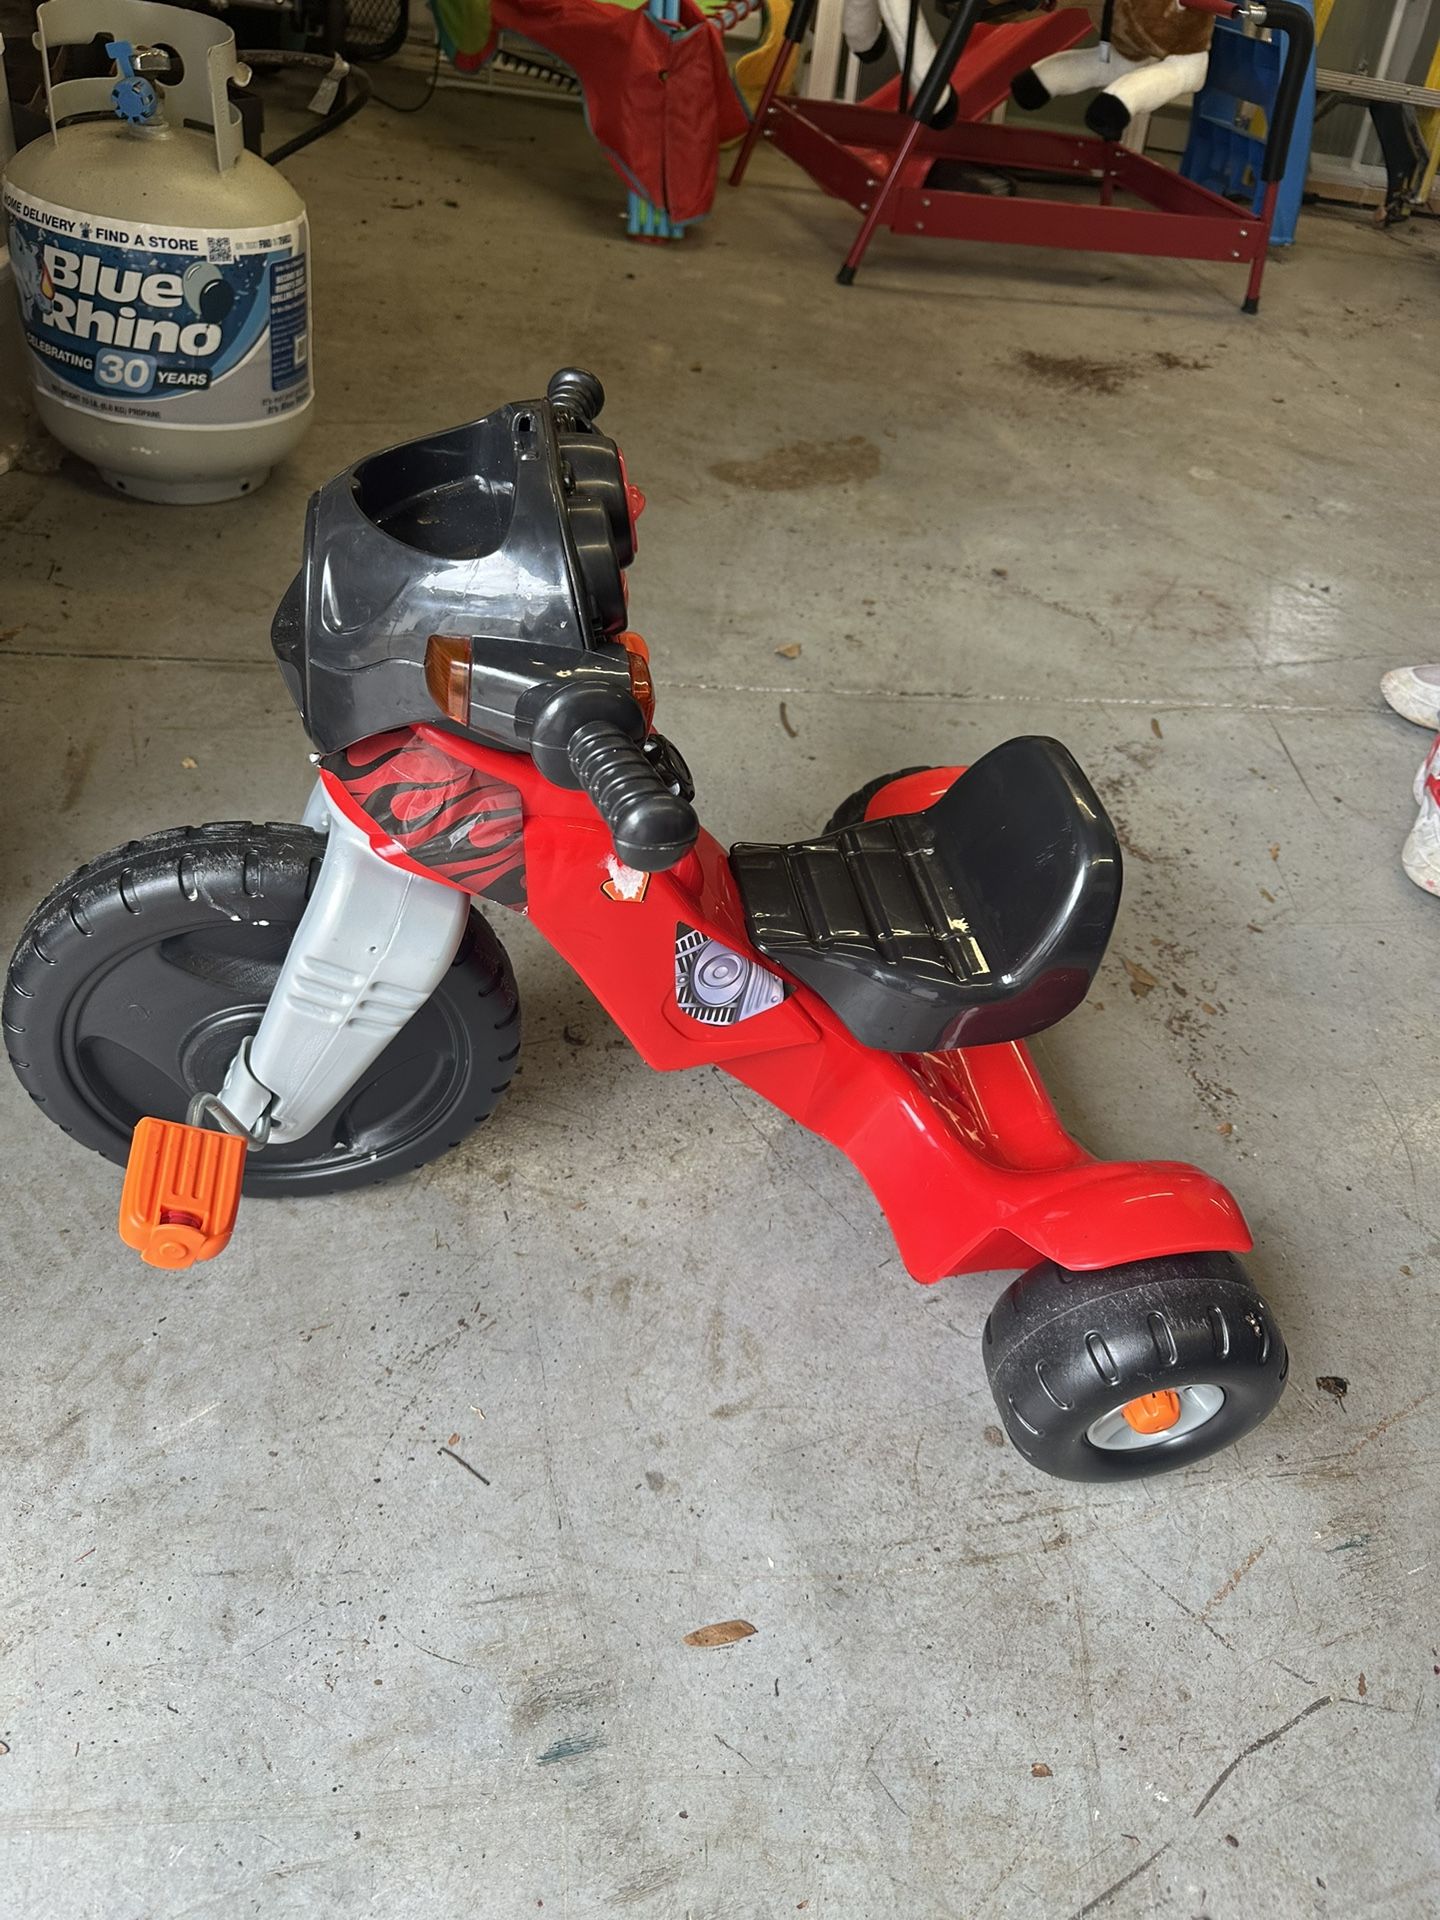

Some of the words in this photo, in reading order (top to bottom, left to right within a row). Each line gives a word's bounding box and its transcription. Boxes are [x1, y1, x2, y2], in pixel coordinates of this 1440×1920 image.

[4, 193, 22, 213] HOME
[23, 205, 76, 233] DELIVERY
[96, 228, 130, 244] FIND
[134, 235, 145, 247] A
[148, 236, 199, 251] STORE
[43, 244, 183, 308] Blue
[43, 291, 223, 357] Rhino
[26, 332, 93, 371] CELEBRATING
[100, 354, 150, 389] 30
[158, 371, 208, 386] YEARS
